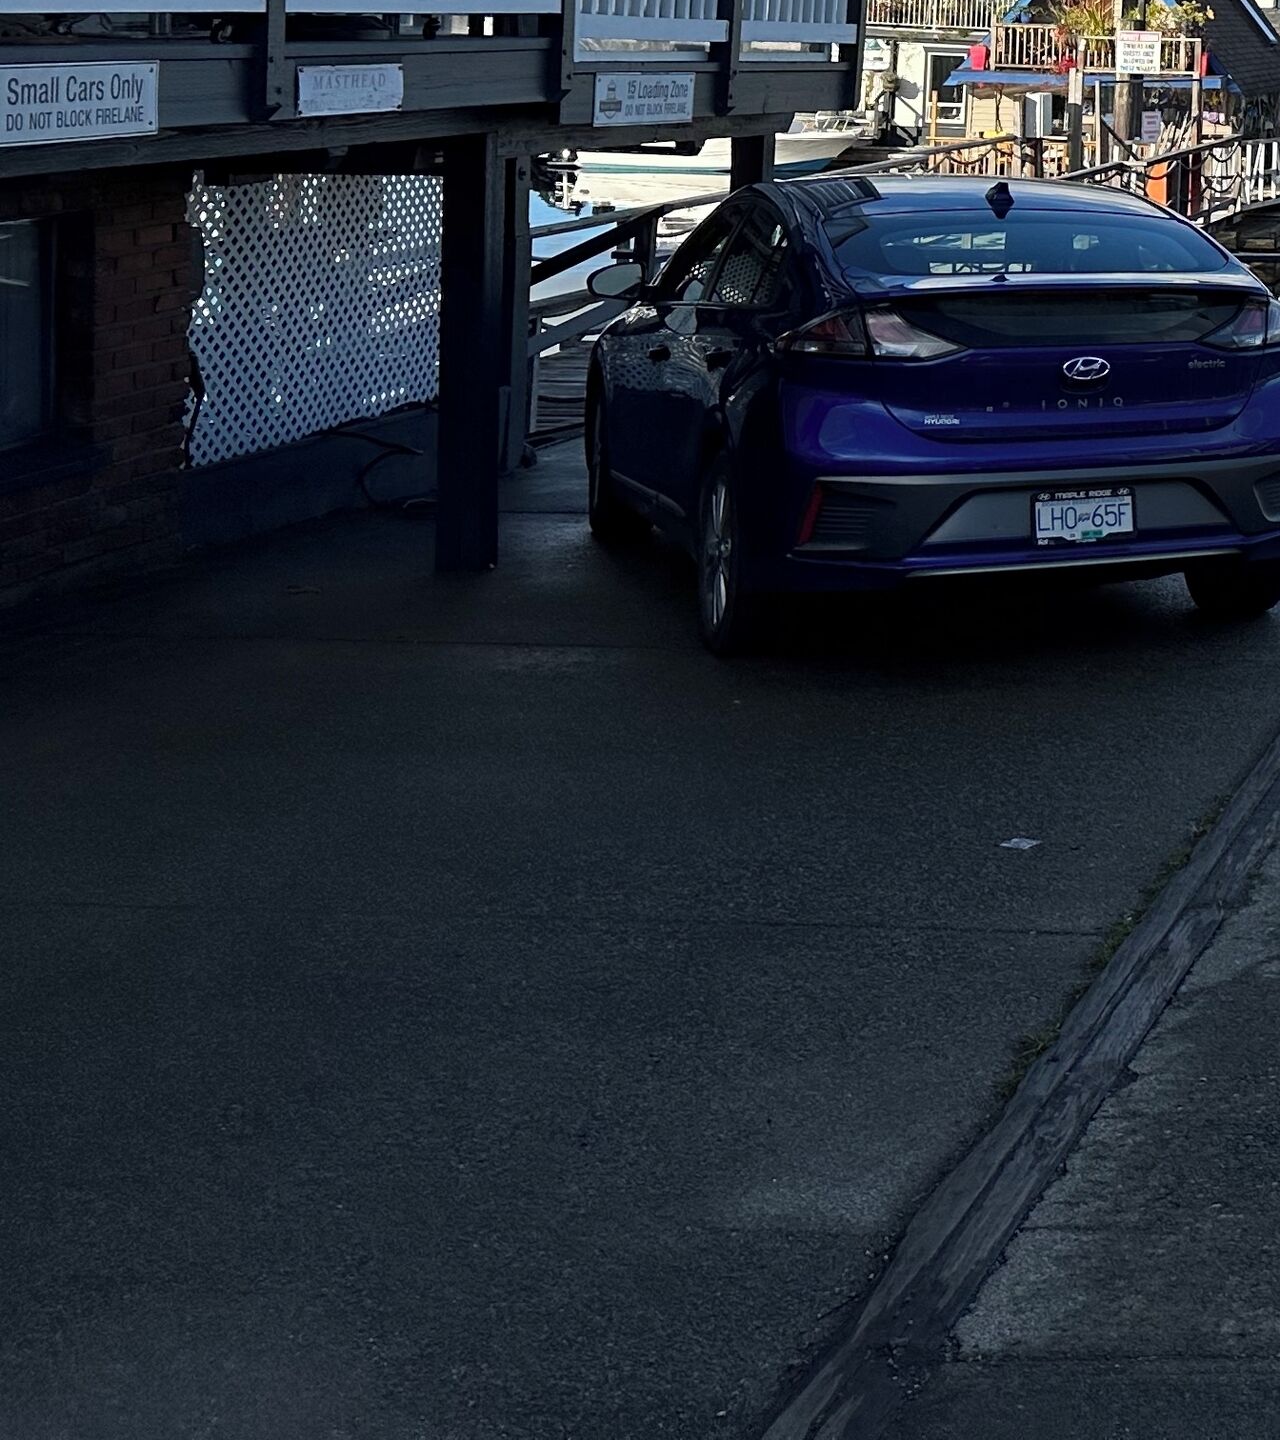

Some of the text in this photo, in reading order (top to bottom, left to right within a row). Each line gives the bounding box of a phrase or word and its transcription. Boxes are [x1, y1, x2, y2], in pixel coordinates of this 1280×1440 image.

[7, 73, 144, 105] Small Cars Only
[312, 72, 386, 90] MASTHEAD
[627, 80, 689, 101] 15 Loading Zone
[6, 105, 144, 131] DO NOT BLOCK FIRELANE
[1188, 358, 1226, 369] electric
[1040, 396, 1125, 411] IONIQ
[1054, 491, 1087, 499] MAPLE
